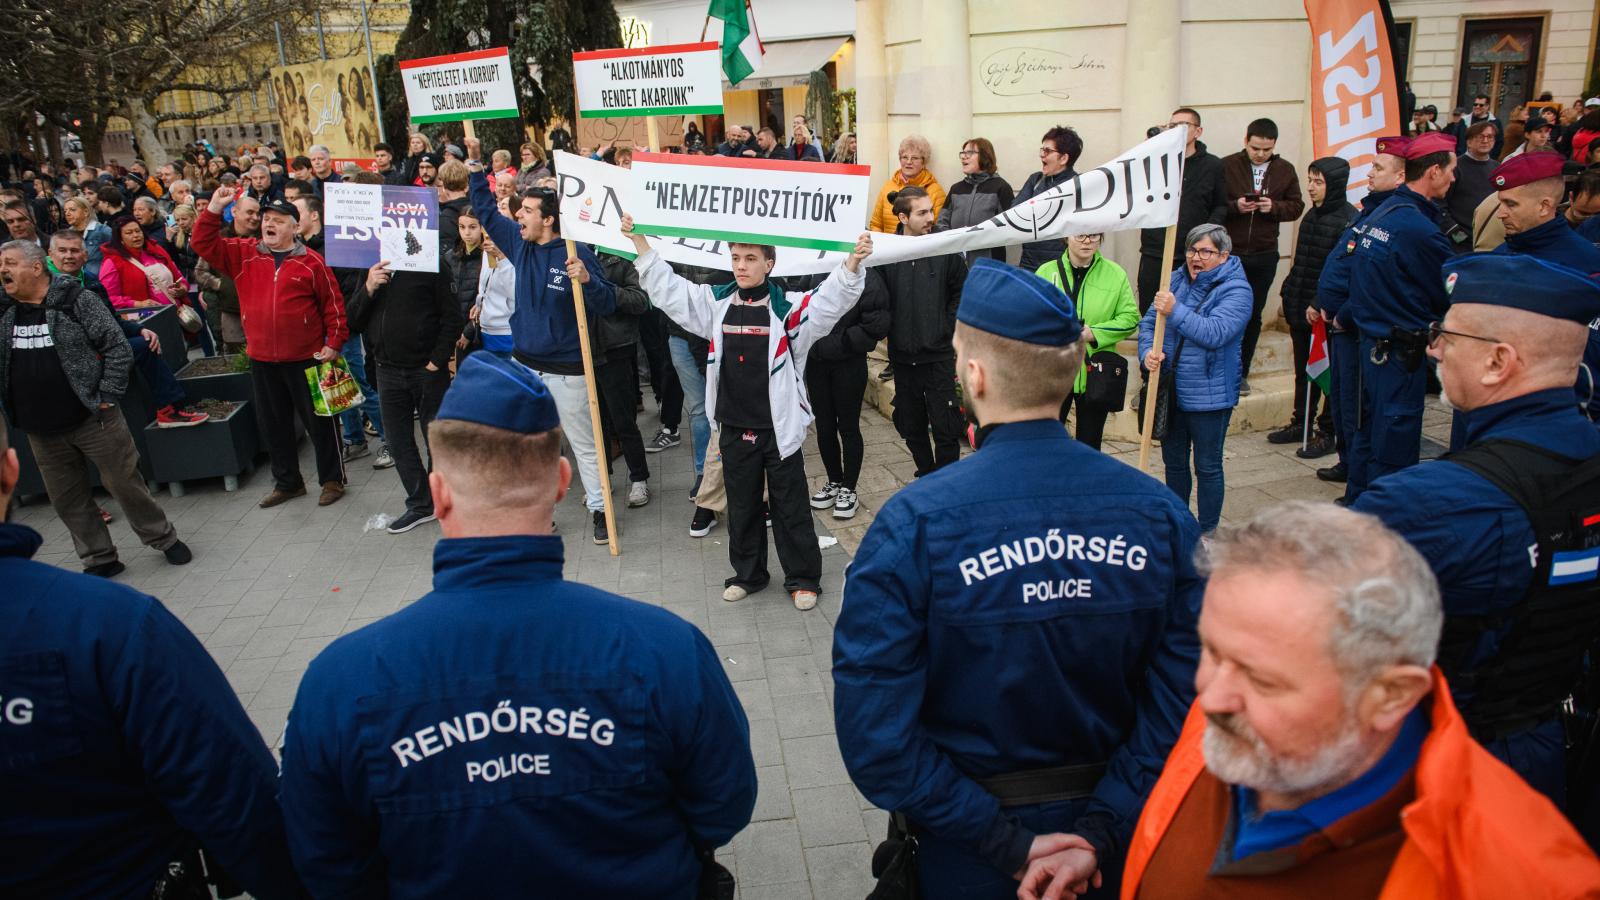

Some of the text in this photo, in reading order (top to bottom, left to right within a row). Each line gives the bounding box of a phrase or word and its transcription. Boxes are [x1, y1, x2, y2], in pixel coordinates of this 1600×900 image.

[463, 69, 469, 85] A
[469, 64, 500, 83] KORRUPT
[431, 91, 454, 111] CSALÓ
[601, 86, 694, 108] RENDET AKARUNK”
[645, 180, 852, 223] “NEMZETPUSZTÍTÓK”
[958, 528, 1148, 586] RENDŐRSÉG
[1022, 578, 1092, 604] POLICE
[390, 699, 616, 768] RENDŐRSÉG
[466, 753, 551, 783] POLICE
